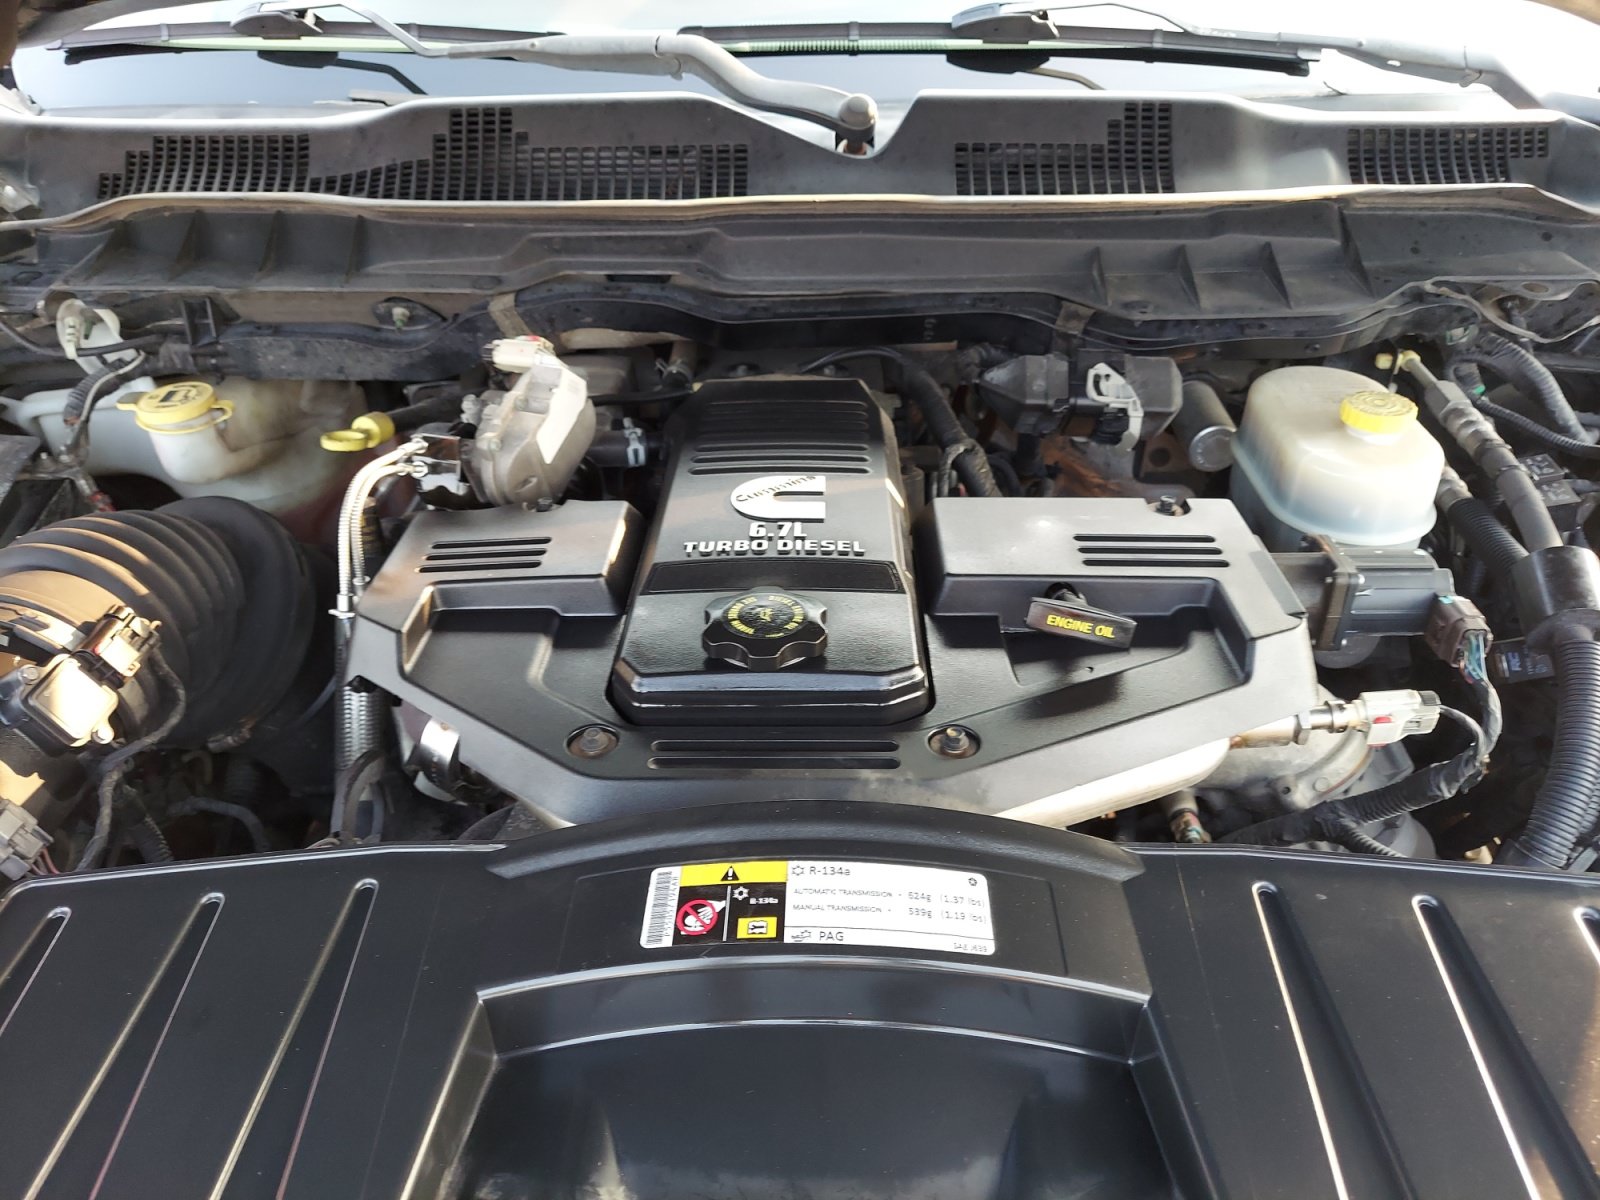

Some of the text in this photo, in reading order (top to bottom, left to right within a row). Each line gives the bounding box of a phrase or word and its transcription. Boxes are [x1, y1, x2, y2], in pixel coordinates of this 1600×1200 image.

[749, 521, 807, 538] 6.7L
[684, 539, 866, 554] TURBO DIESEL
[1046, 614, 1116, 639] ENGINE OIL
[808, 865, 851, 877] R-134a
[793, 887, 837, 896] AUTOMATIC
[838, 888, 893, 898] TRANSMISSION
[792, 903, 826, 912] MANUAL
[826, 903, 882, 913] TRANSMISSION
[818, 930, 845, 942] PAG
